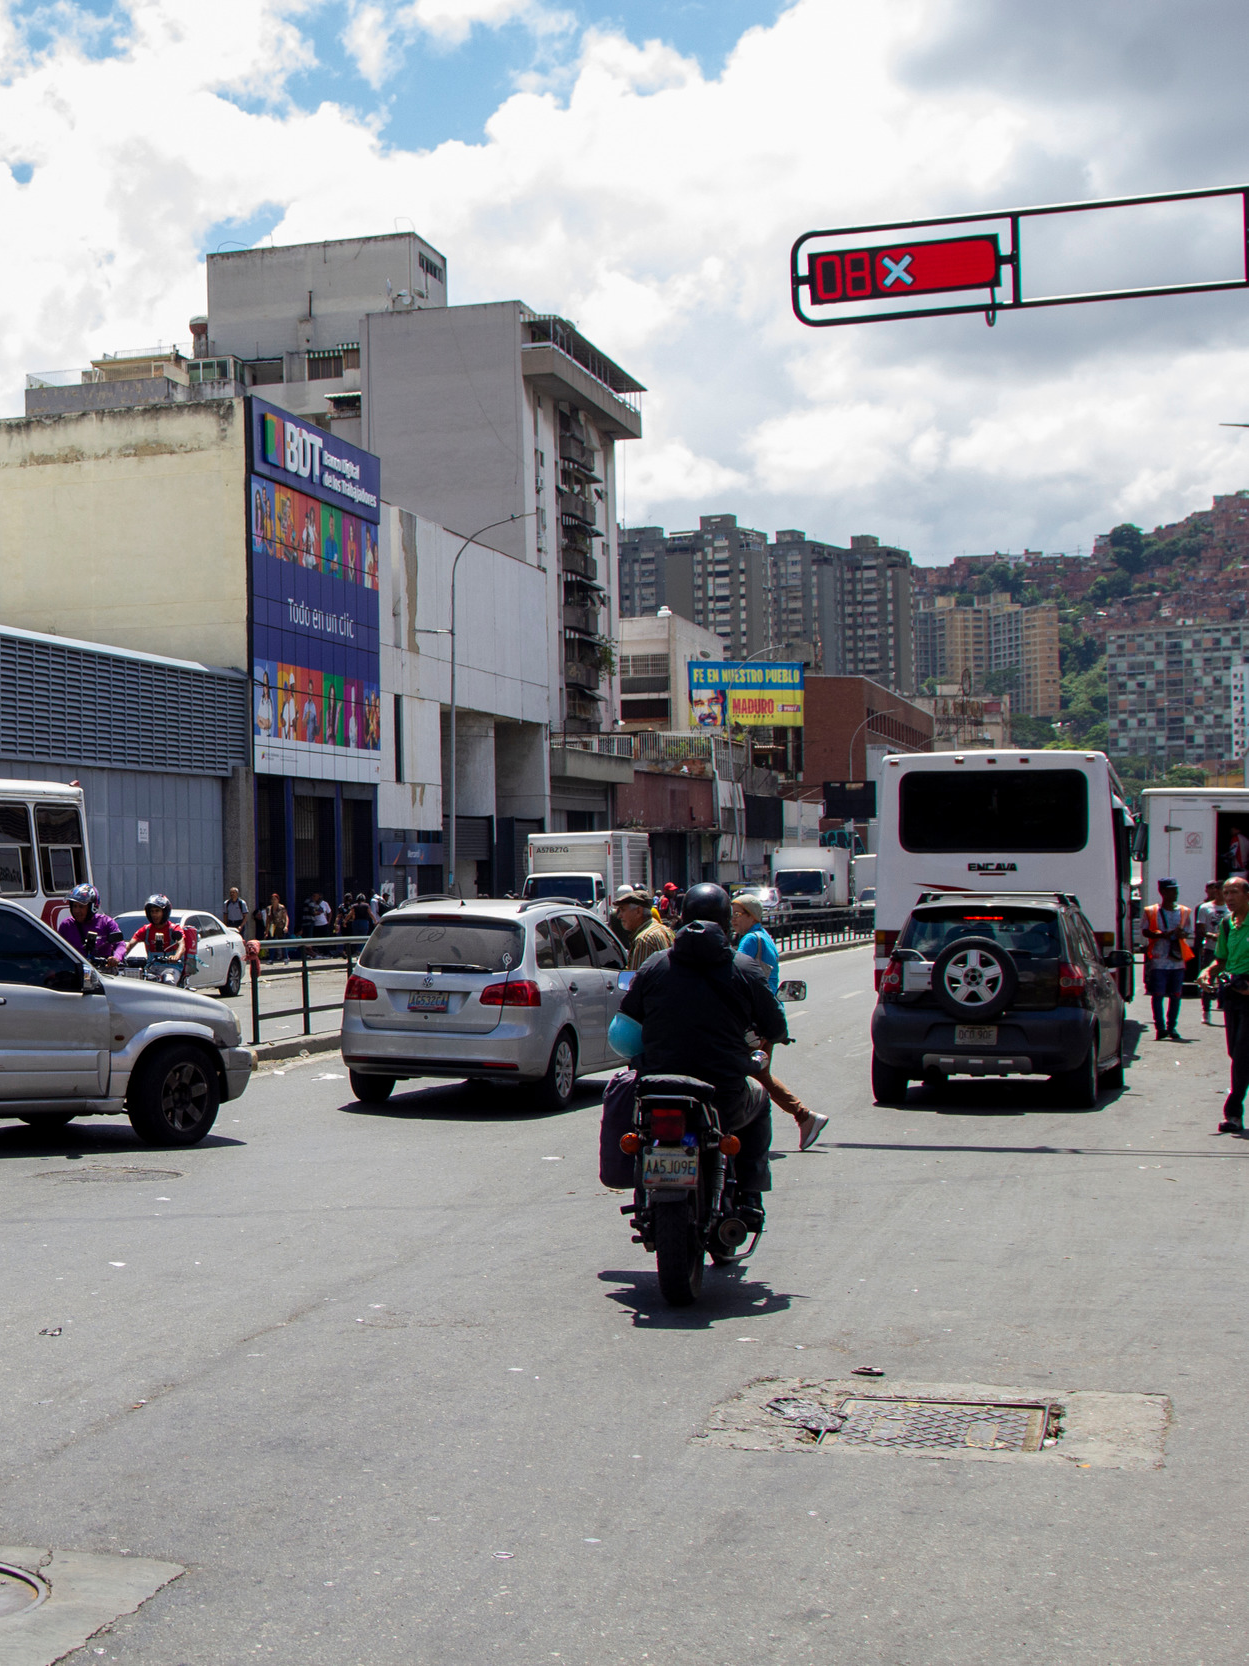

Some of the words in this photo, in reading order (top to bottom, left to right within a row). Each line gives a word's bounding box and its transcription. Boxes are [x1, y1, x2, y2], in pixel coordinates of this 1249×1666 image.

[815, 251, 872, 300] 08
[284, 421, 323, 484] BDT
[287, 597, 311, 627] Todo
[312, 608, 325, 630] en
[326, 613, 338, 634] un
[339, 612, 355, 639] clic
[693, 668, 704, 683] FE
[707, 668, 719, 683] EN
[721, 668, 764, 683] NUESTRO
[765, 668, 800, 683] PUEBLO
[732, 698, 774, 714] MADURO
[967, 862, 1018, 871] ENCAVA
[646, 1159, 696, 1175] AA5J09E
